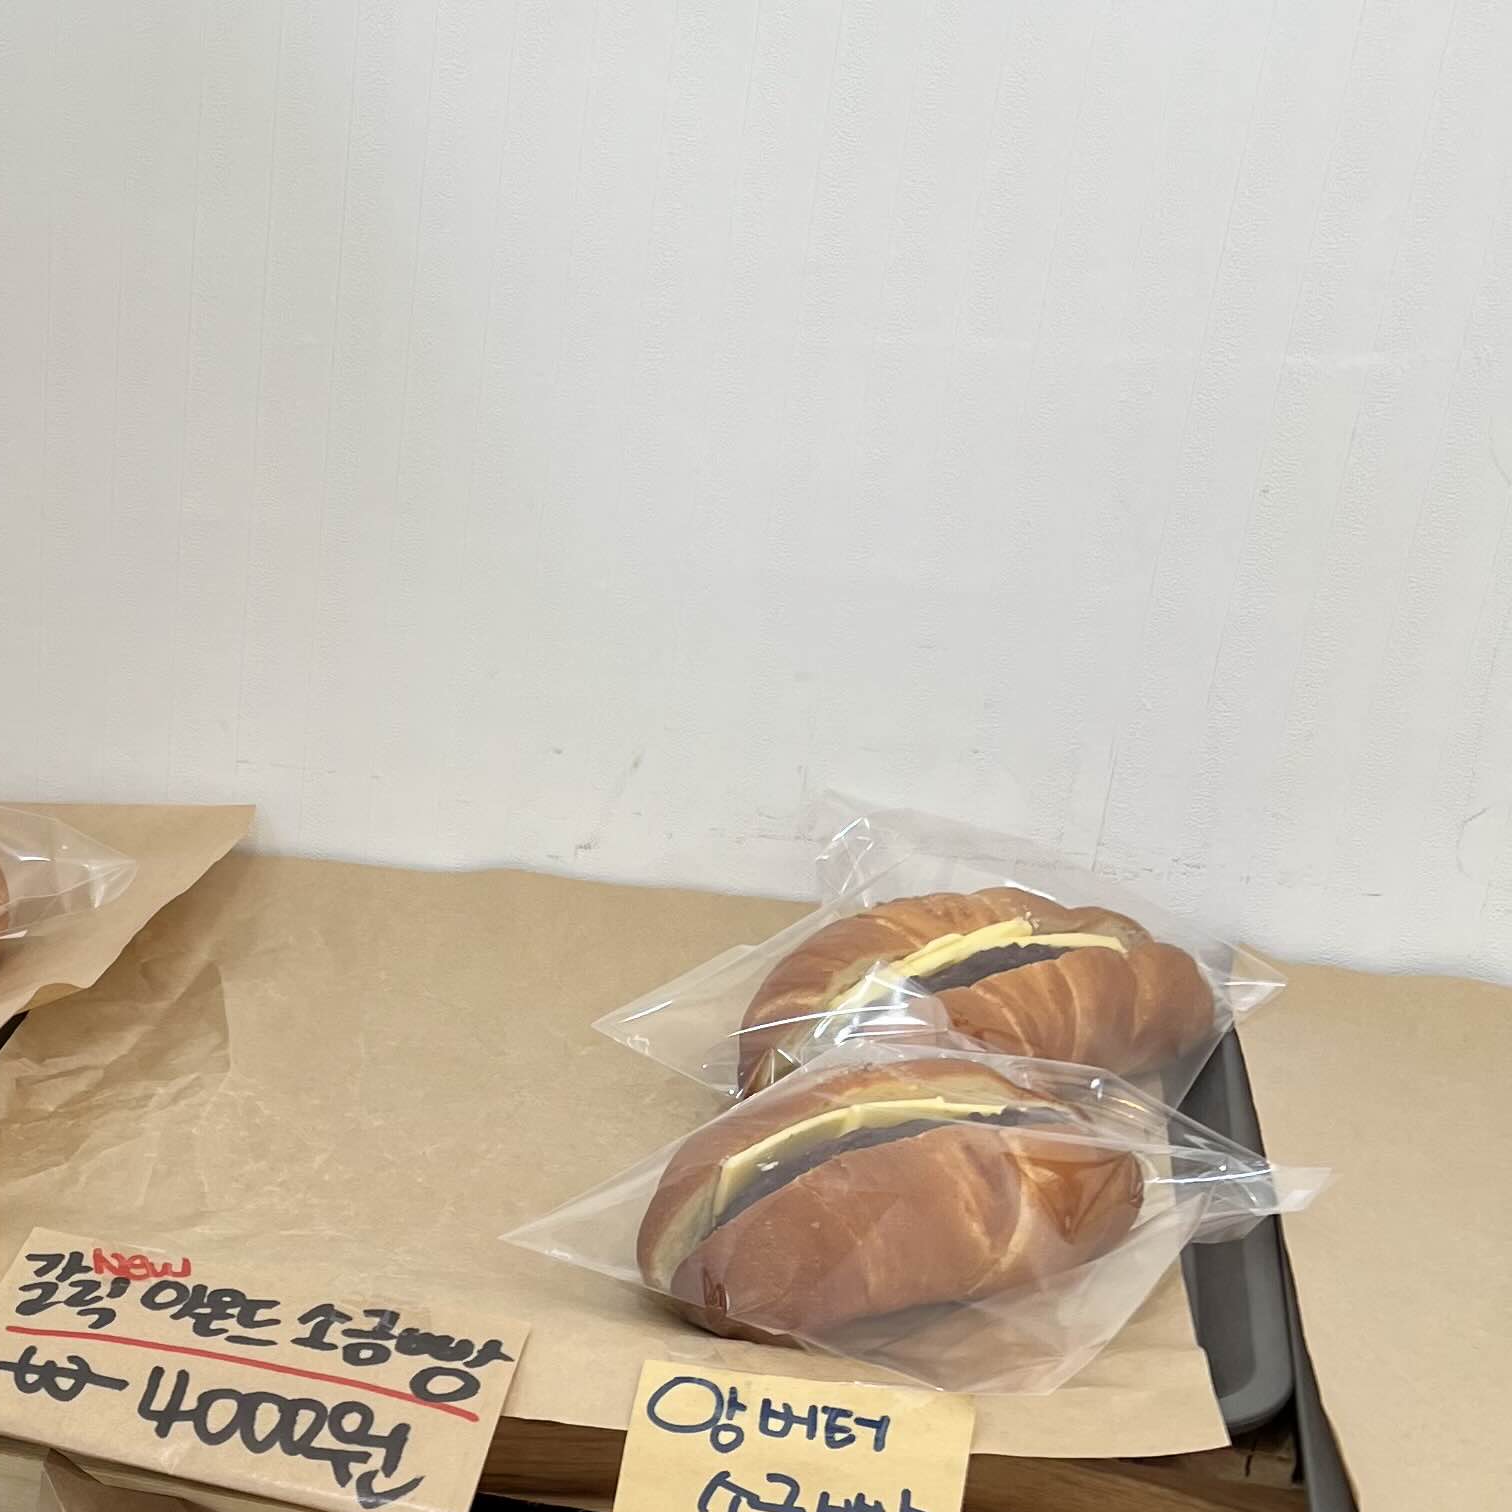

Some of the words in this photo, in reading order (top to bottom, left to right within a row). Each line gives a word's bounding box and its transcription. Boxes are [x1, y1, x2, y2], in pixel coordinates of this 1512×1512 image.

[93, 1248, 192, 1280] New
[15, 1251, 131, 1330] 갈릭
[140, 1280, 282, 1347] 아몬드
[291, 1303, 515, 1403] 소금빵
